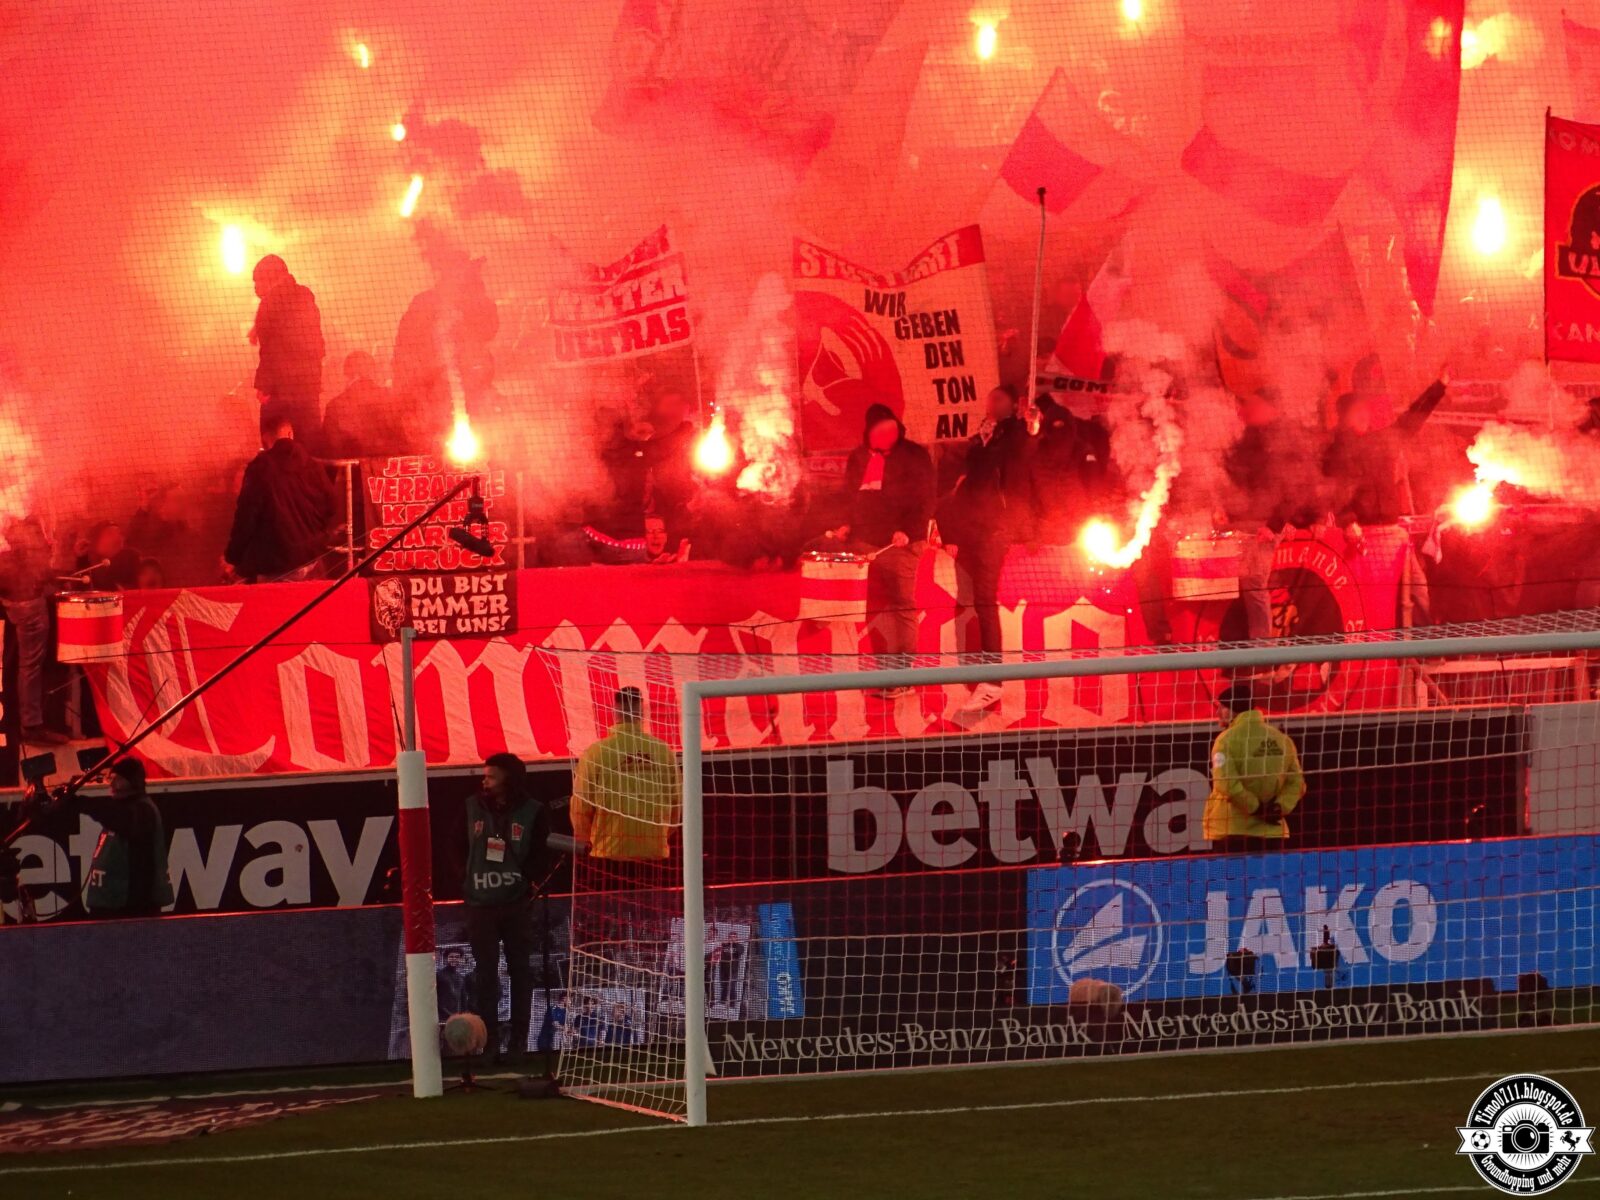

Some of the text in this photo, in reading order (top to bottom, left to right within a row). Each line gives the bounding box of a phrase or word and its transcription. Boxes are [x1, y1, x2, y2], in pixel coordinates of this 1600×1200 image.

[864, 288, 906, 318] WIR
[554, 307, 690, 362] ULTRAS
[894, 309, 961, 341] GEBEN
[924, 340, 964, 369] DEN
[932, 375, 977, 405] TON
[936, 413, 968, 439] AN
[409, 573, 508, 595] DU BIST
[411, 594, 511, 617] IMMER
[412, 615, 511, 634] BEI UNS!
[1188, 879, 1438, 975] JAKO
[1123, 989, 1483, 1040] Mercedes-Benz Bank
[722, 1015, 1091, 1062] Mercedes-Benz Bank
